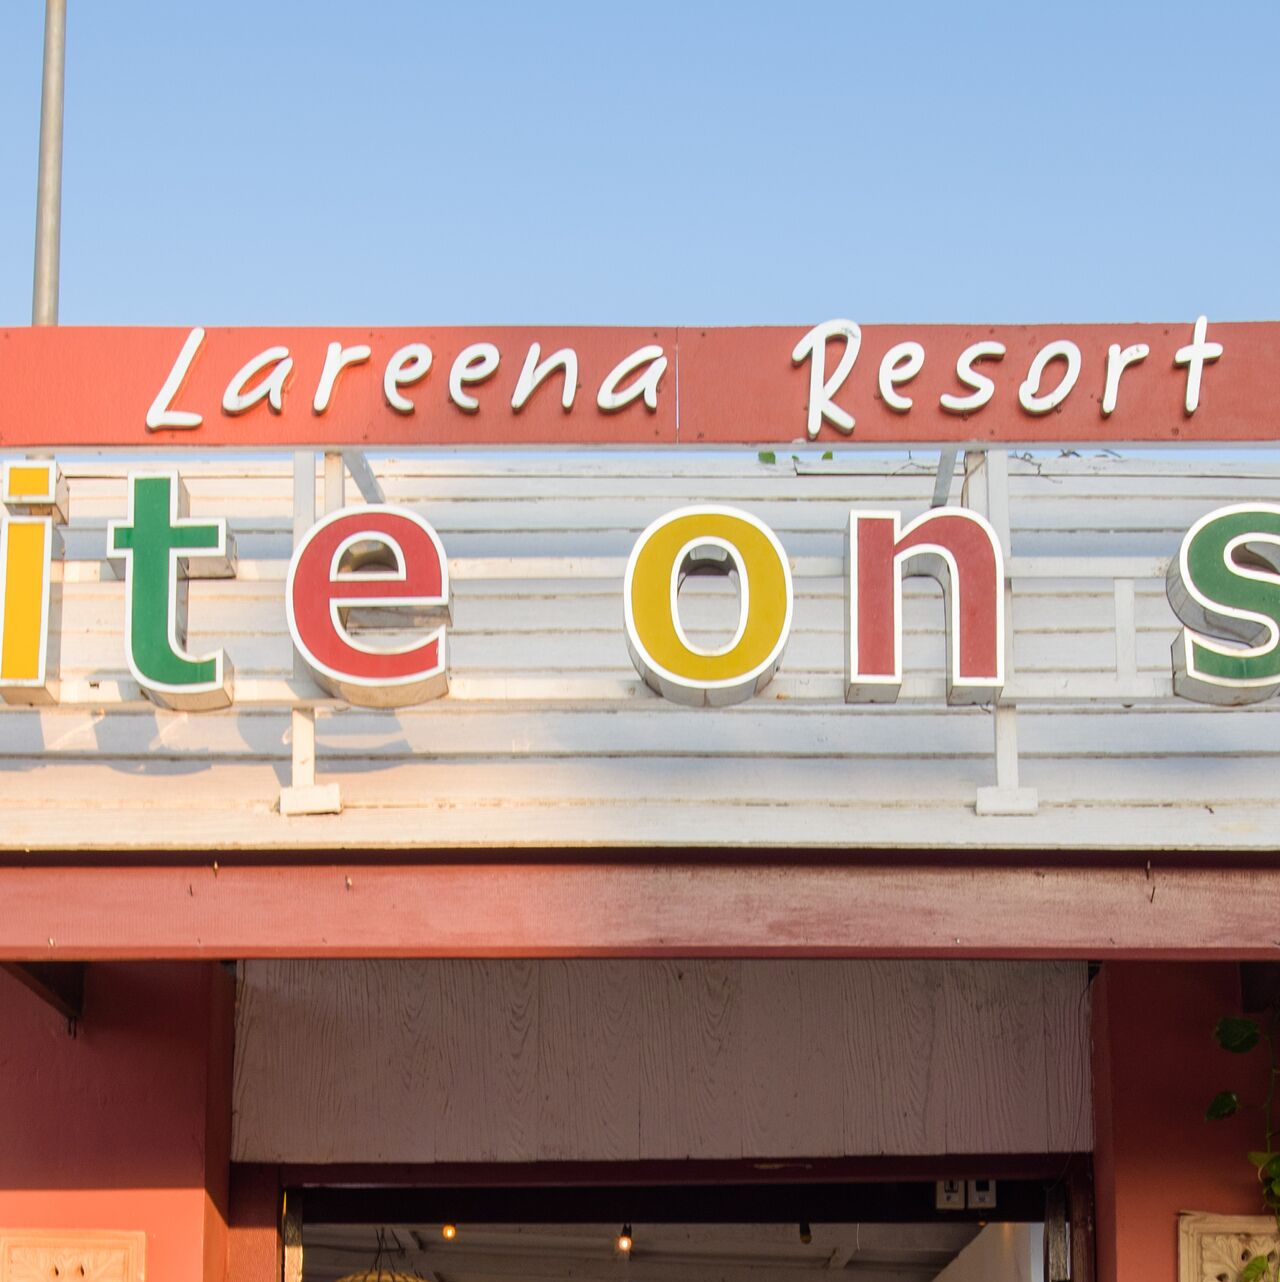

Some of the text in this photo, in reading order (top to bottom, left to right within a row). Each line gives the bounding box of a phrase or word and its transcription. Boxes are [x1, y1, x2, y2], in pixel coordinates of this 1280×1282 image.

[146, 315, 1223, 437] Lareena Resort
[623, 504, 1007, 704] on
